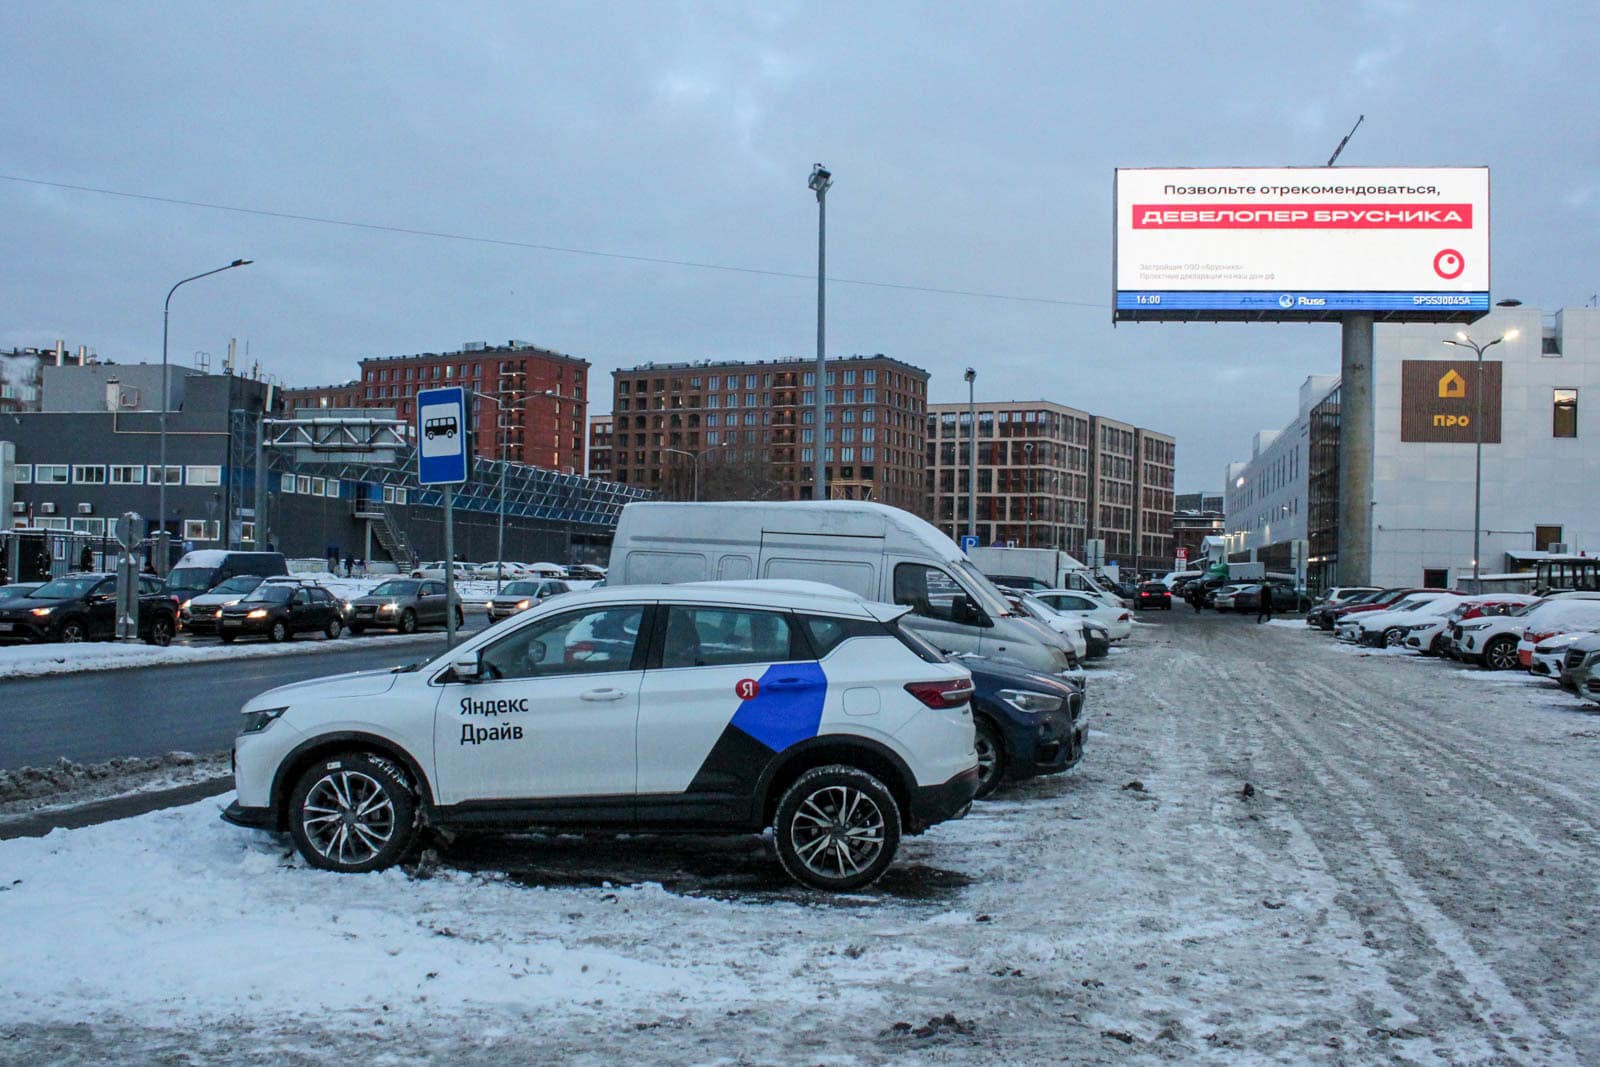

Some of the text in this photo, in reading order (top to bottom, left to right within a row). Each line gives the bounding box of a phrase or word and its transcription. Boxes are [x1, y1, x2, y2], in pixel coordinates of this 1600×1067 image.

[1164, 184, 1441, 197] Позвольте отрекомендоваться,
[1141, 210, 1463, 225] ДЕВЕЛОПЕР БРУСНИКА
[1136, 295, 1161, 304] 16:00
[1298, 296, 1326, 305] Russ
[1433, 414, 1470, 427] ПРО
[742, 681, 754, 697] Я
[460, 697, 529, 717] Яндекс
[460, 722, 524, 745] Драйв
